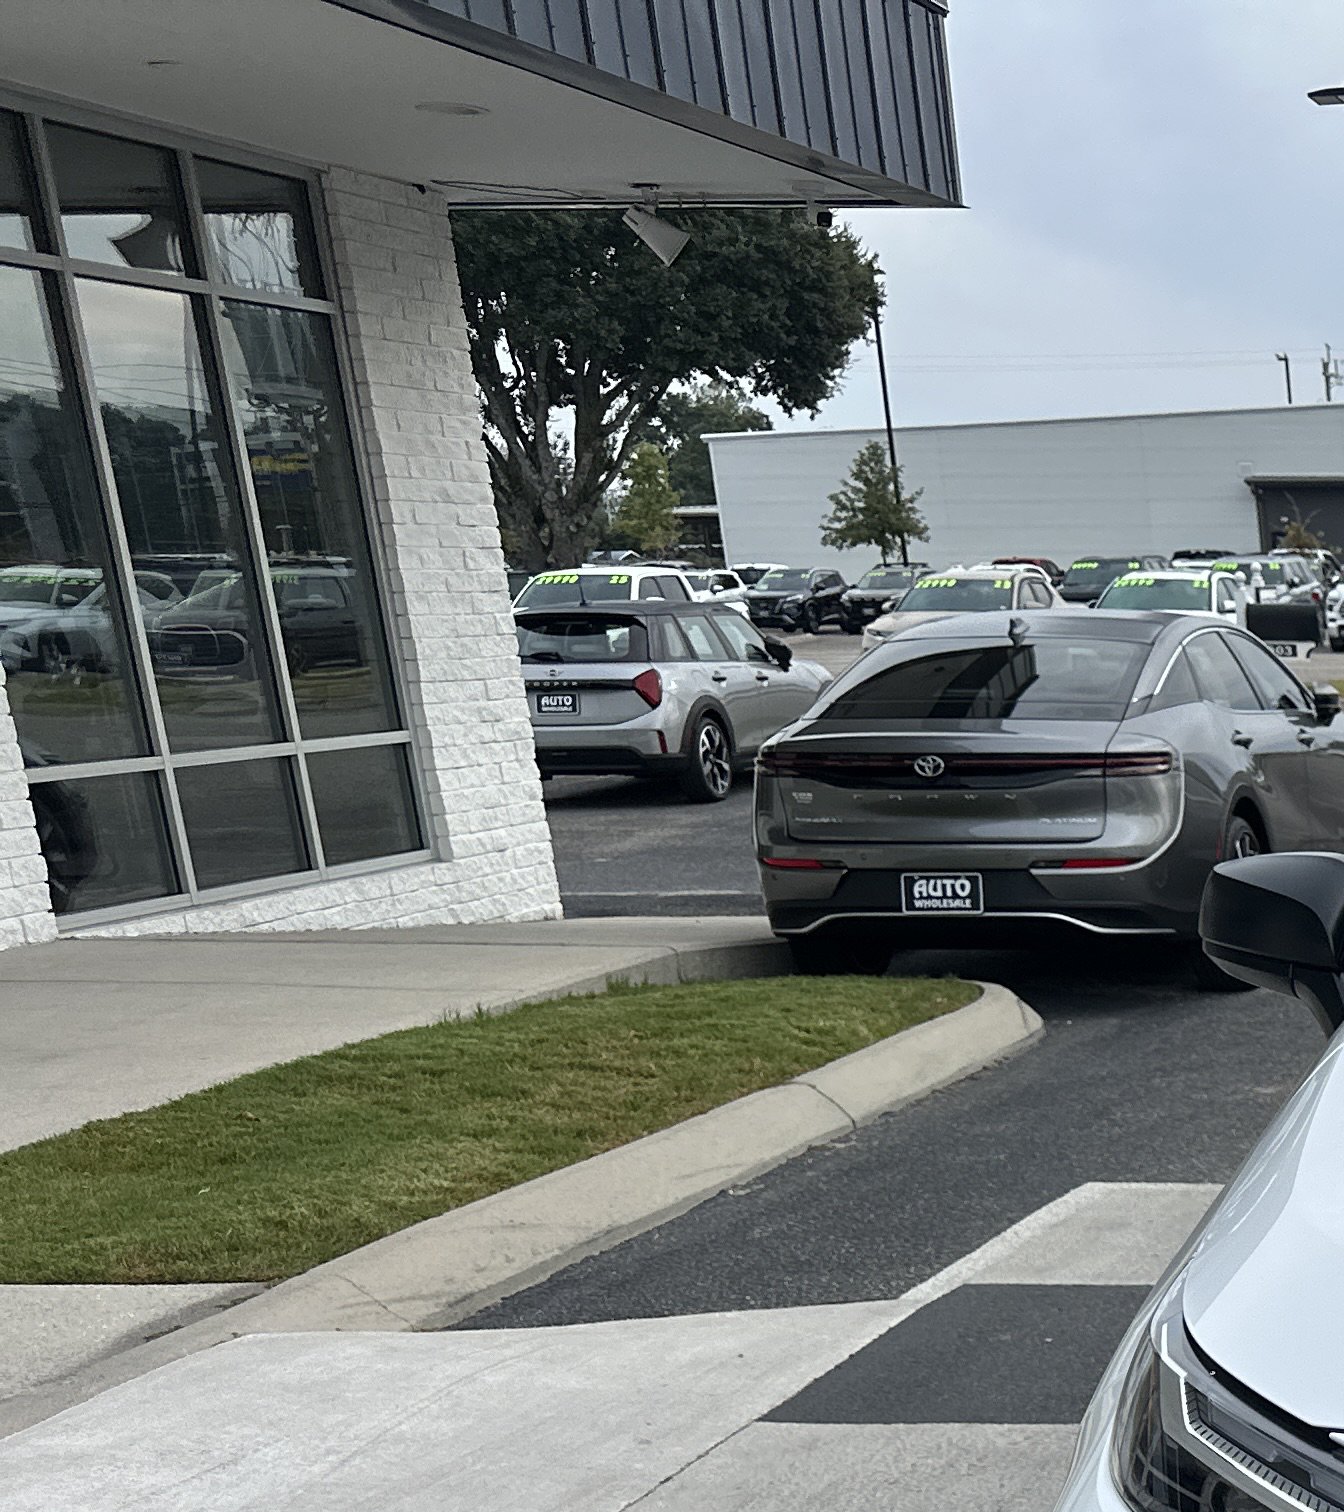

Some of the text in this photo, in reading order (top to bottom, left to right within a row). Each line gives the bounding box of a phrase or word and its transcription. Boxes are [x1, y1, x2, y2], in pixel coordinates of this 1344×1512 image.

[541, 696, 573, 706] AUTO
[913, 879, 971, 898] AUTO
[913, 898, 972, 909] WHOLESALE
